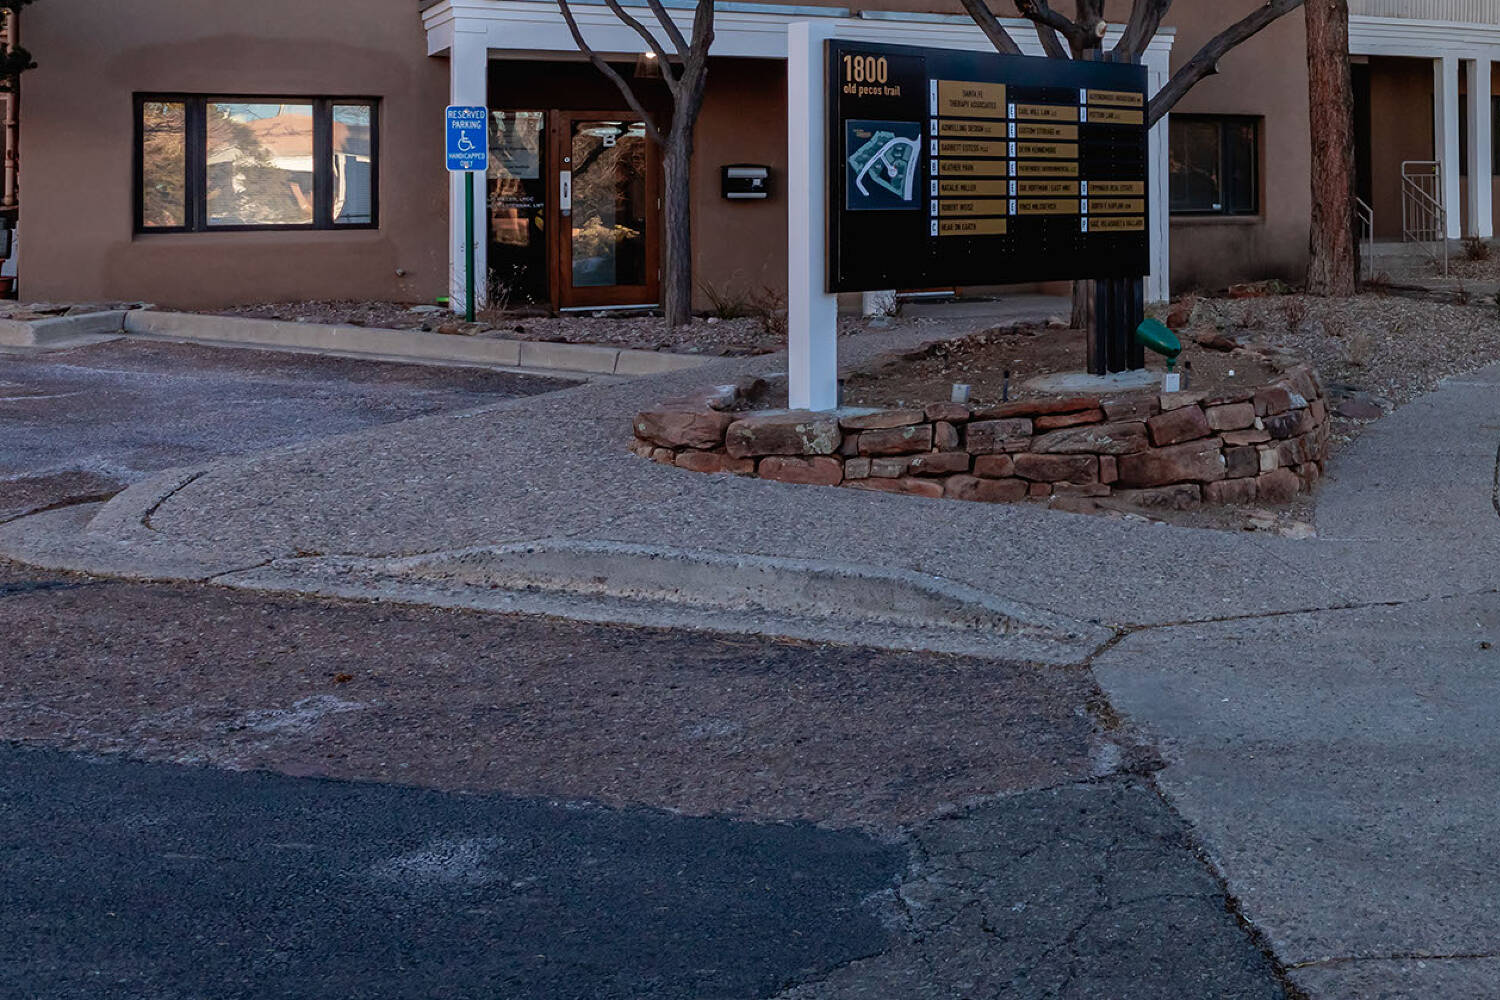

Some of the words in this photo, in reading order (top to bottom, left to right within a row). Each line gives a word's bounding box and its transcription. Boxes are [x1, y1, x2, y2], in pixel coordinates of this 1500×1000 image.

[843, 55, 887, 83] 1800
[843, 83, 857, 94] old
[858, 86, 882, 97] pecos
[883, 85, 901, 97] trail
[447, 110, 486, 119] RESERVED
[451, 120, 482, 129] PARKING
[603, 134, 616, 148] B
[448, 152, 486, 160] HANDICAPPED
